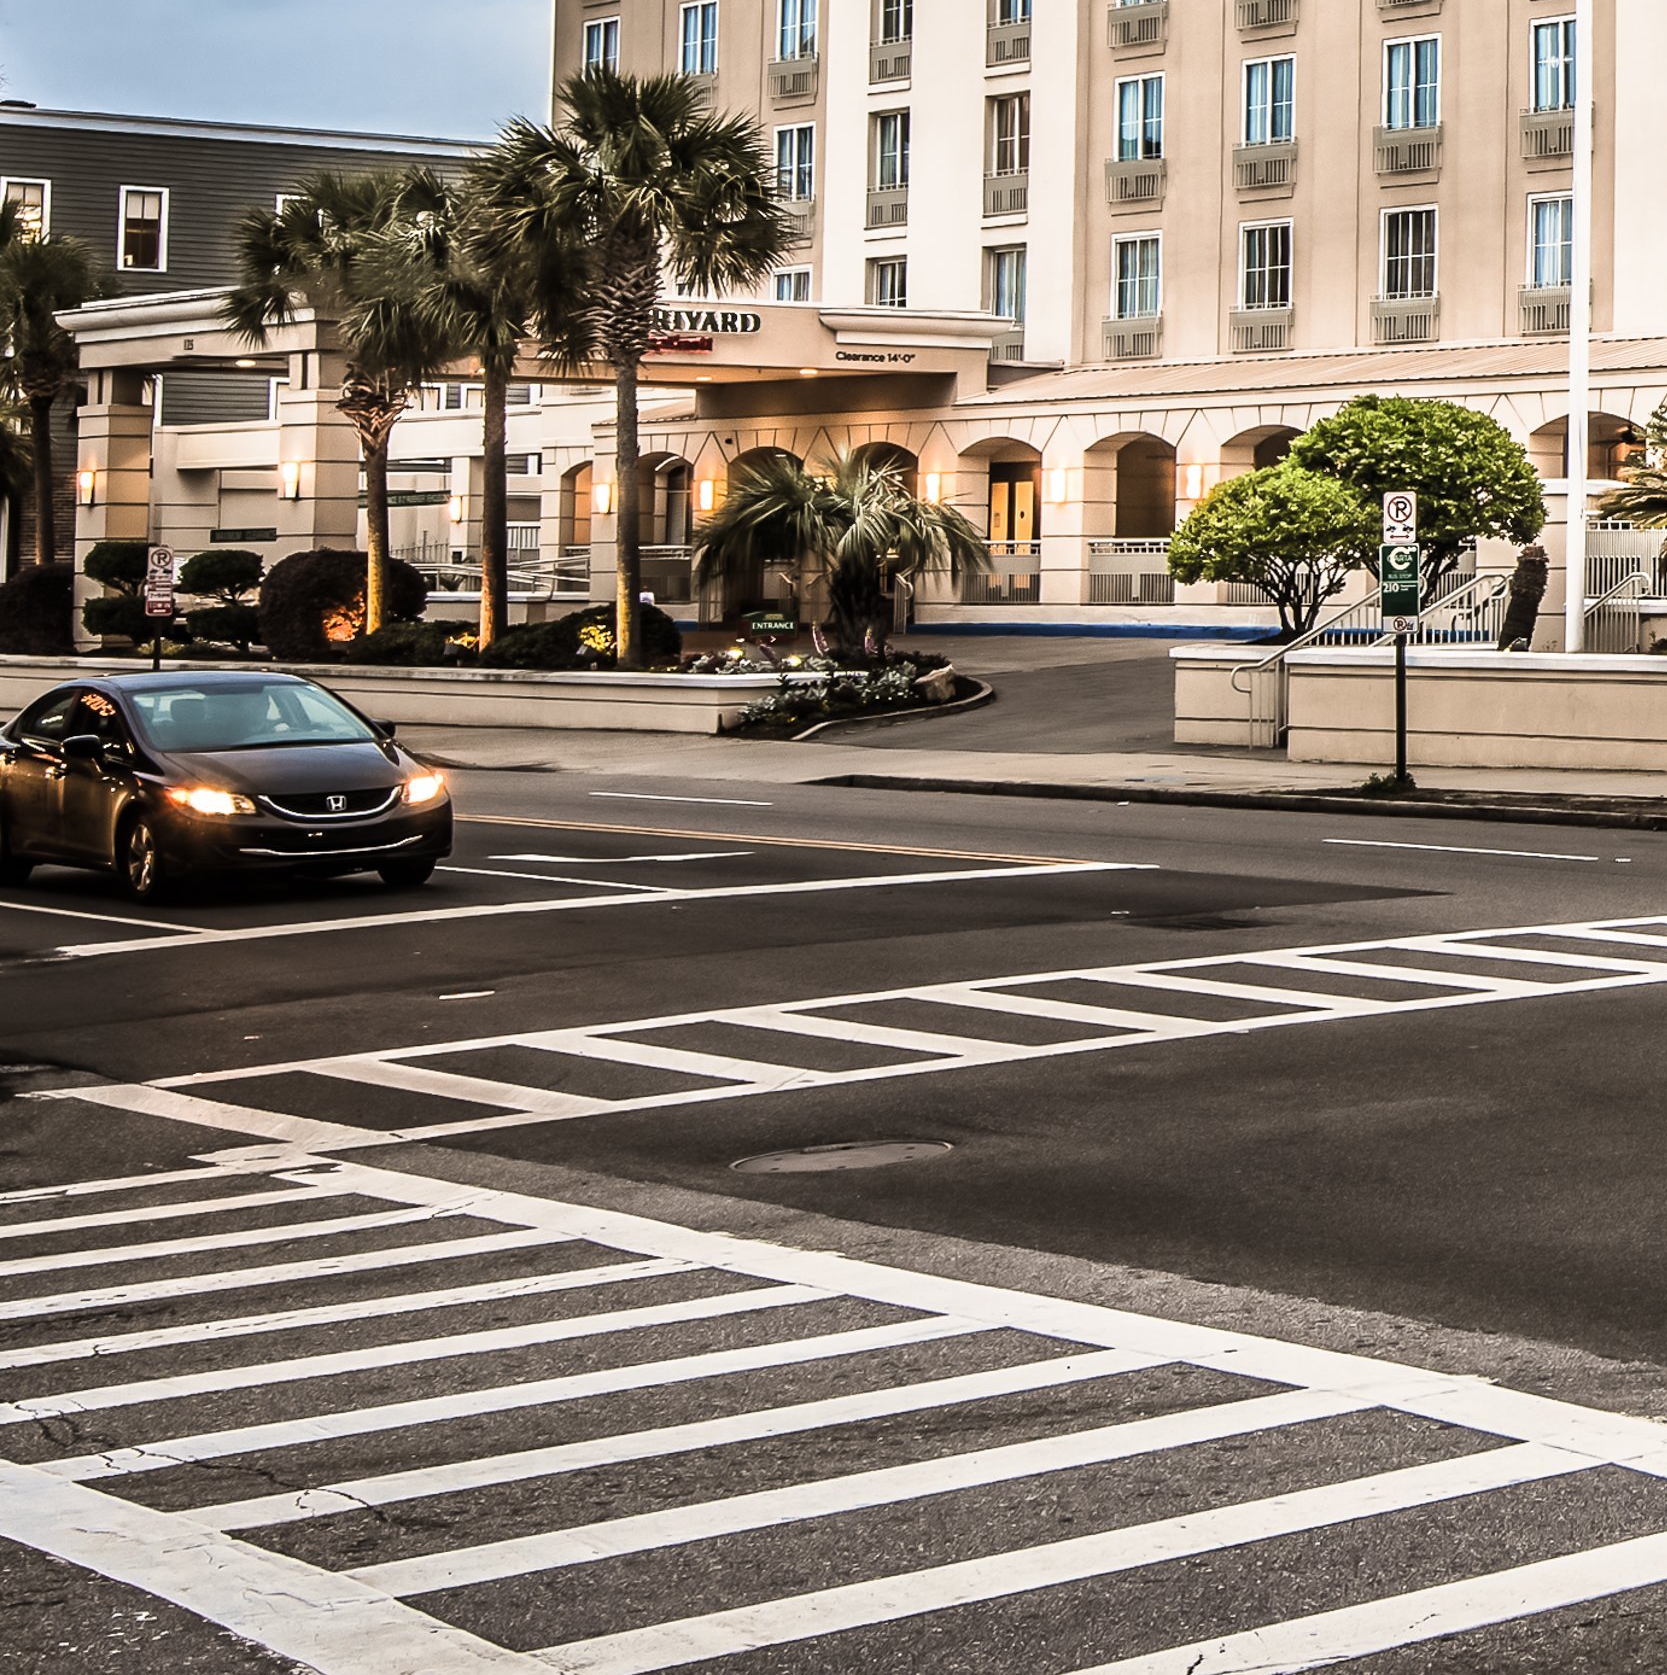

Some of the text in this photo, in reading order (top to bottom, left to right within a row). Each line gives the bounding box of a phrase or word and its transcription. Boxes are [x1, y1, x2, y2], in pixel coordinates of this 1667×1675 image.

[650, 308, 761, 333] RTYARD
[836, 351, 885, 362] Clearance
[752, 622, 794, 630] ENTRANCE
